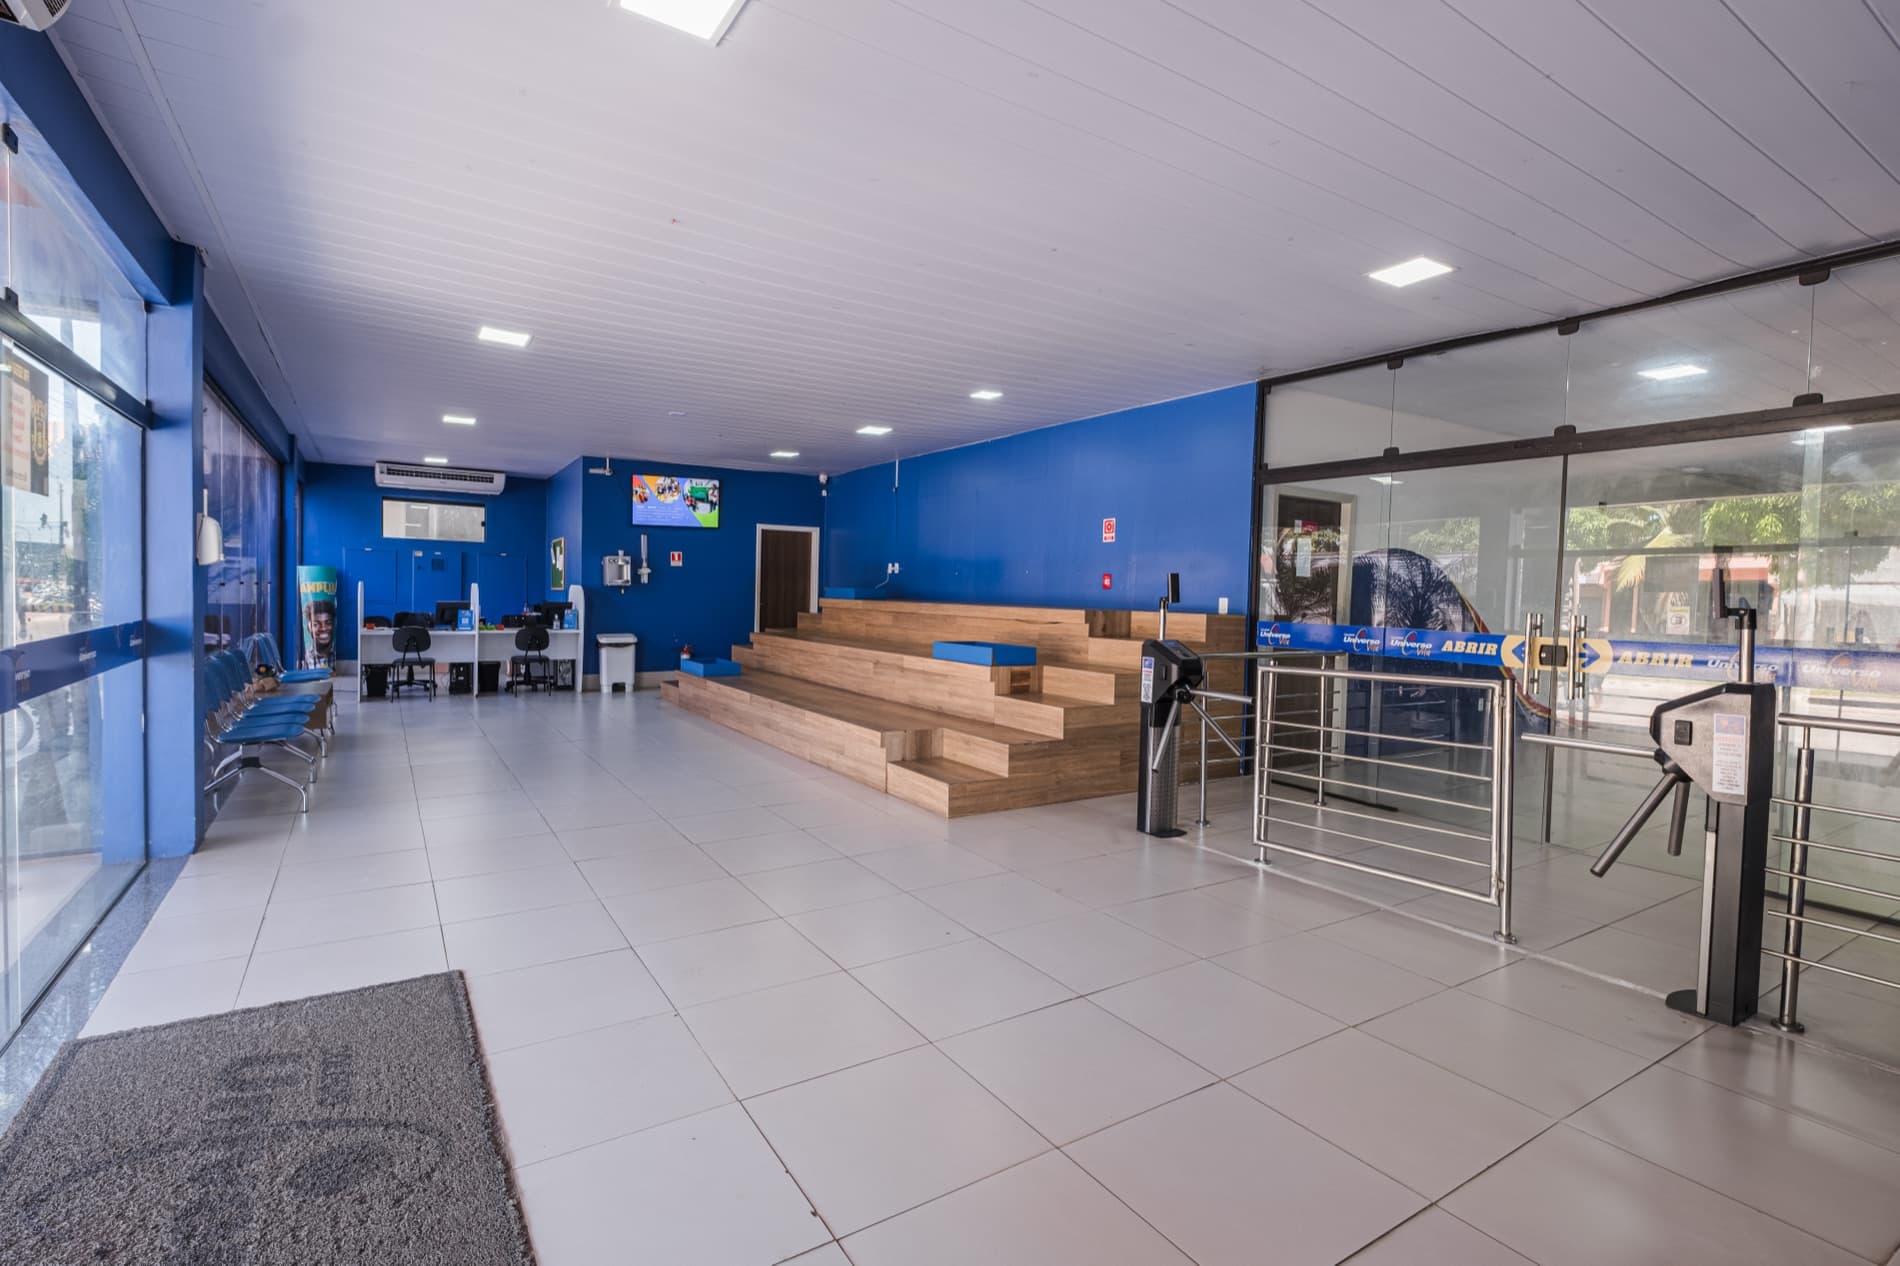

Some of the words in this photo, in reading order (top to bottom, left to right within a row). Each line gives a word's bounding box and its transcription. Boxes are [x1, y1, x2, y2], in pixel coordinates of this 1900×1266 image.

[1391, 639, 1432, 649] Universo
[1441, 639, 1498, 656] ABRIR
[1617, 650, 1694, 668] ABRIR
